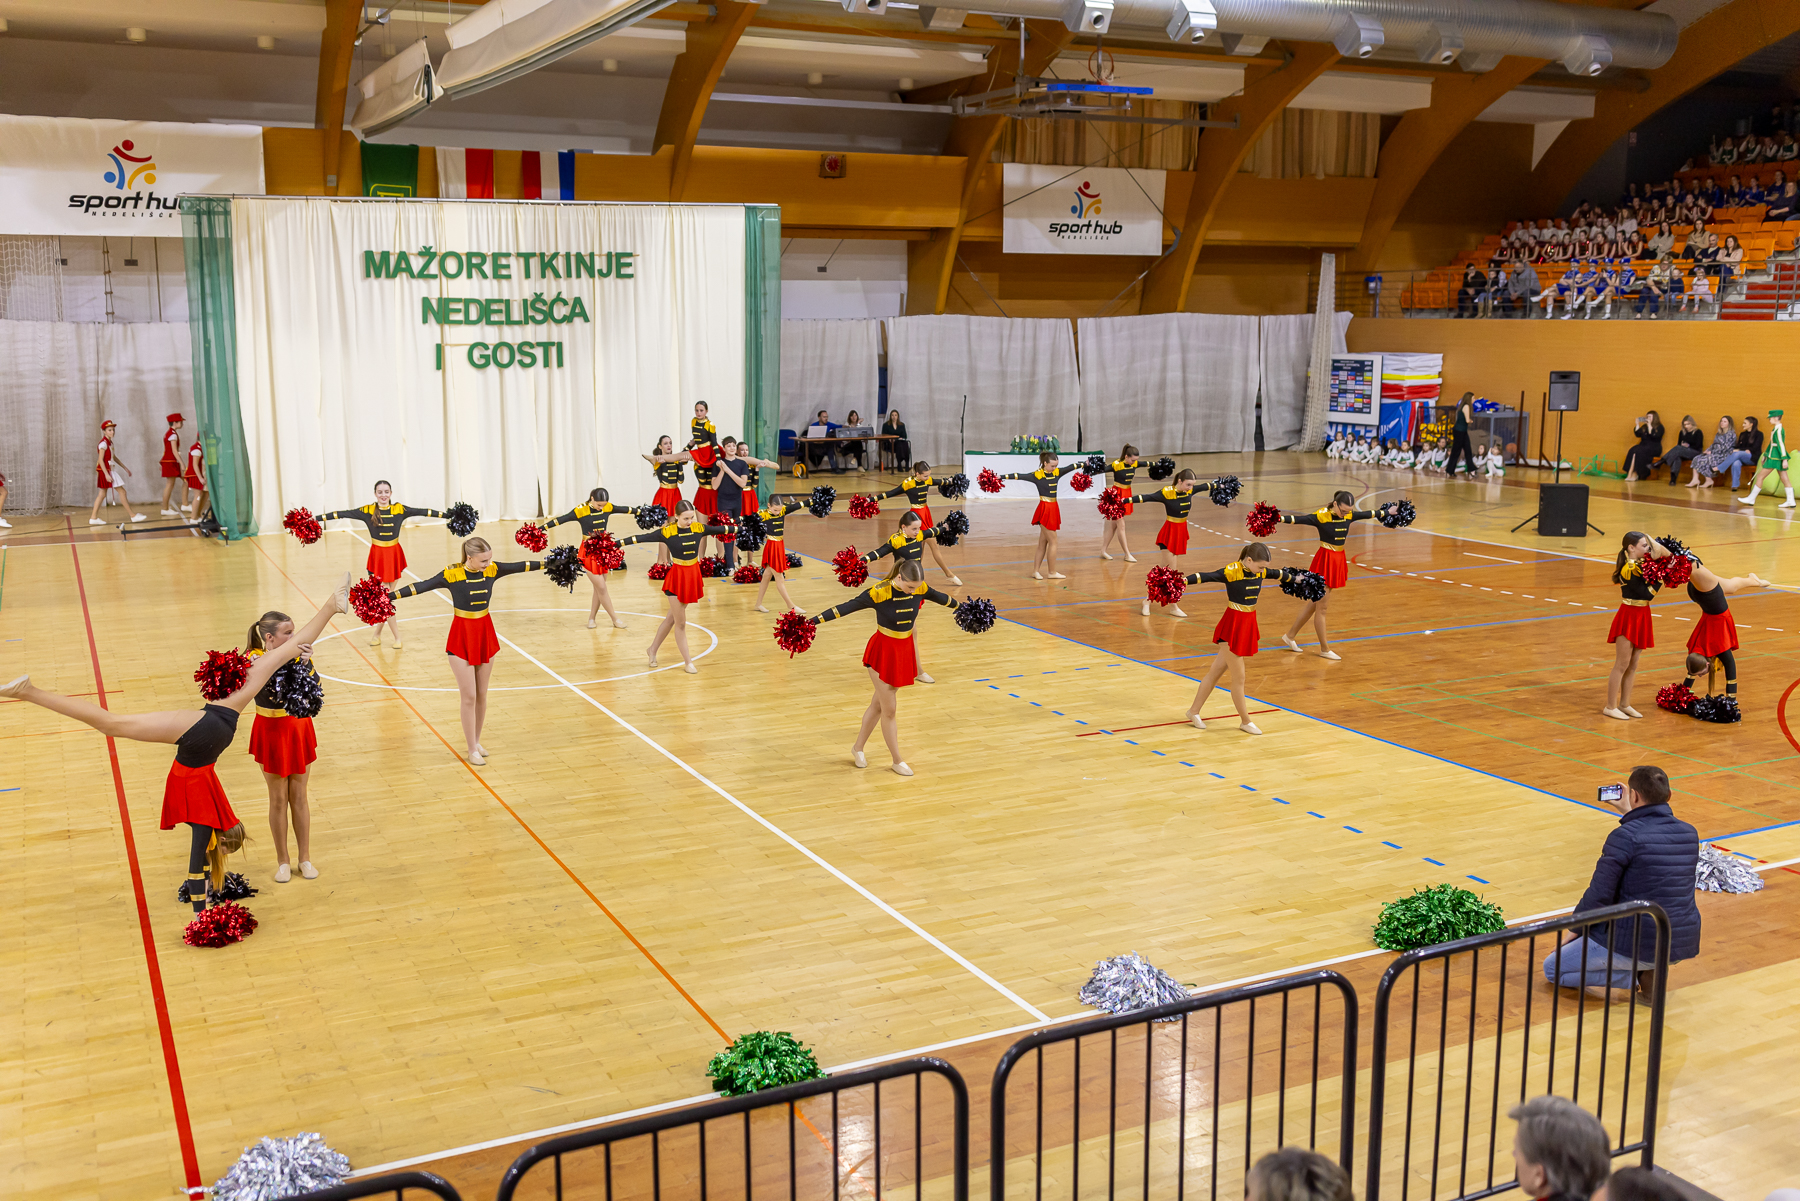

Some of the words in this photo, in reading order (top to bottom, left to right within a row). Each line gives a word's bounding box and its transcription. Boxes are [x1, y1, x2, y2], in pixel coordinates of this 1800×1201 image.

[68, 191, 143, 213] sport
[1048, 220, 1092, 237] sport
[1093, 220, 1123, 235] hub
[364, 246, 634, 279] MAŽORETKINJE
[421, 292, 590, 325] NEDELIŠĆA
[435, 343, 442, 371] I
[467, 341, 563, 369] GOSTI
